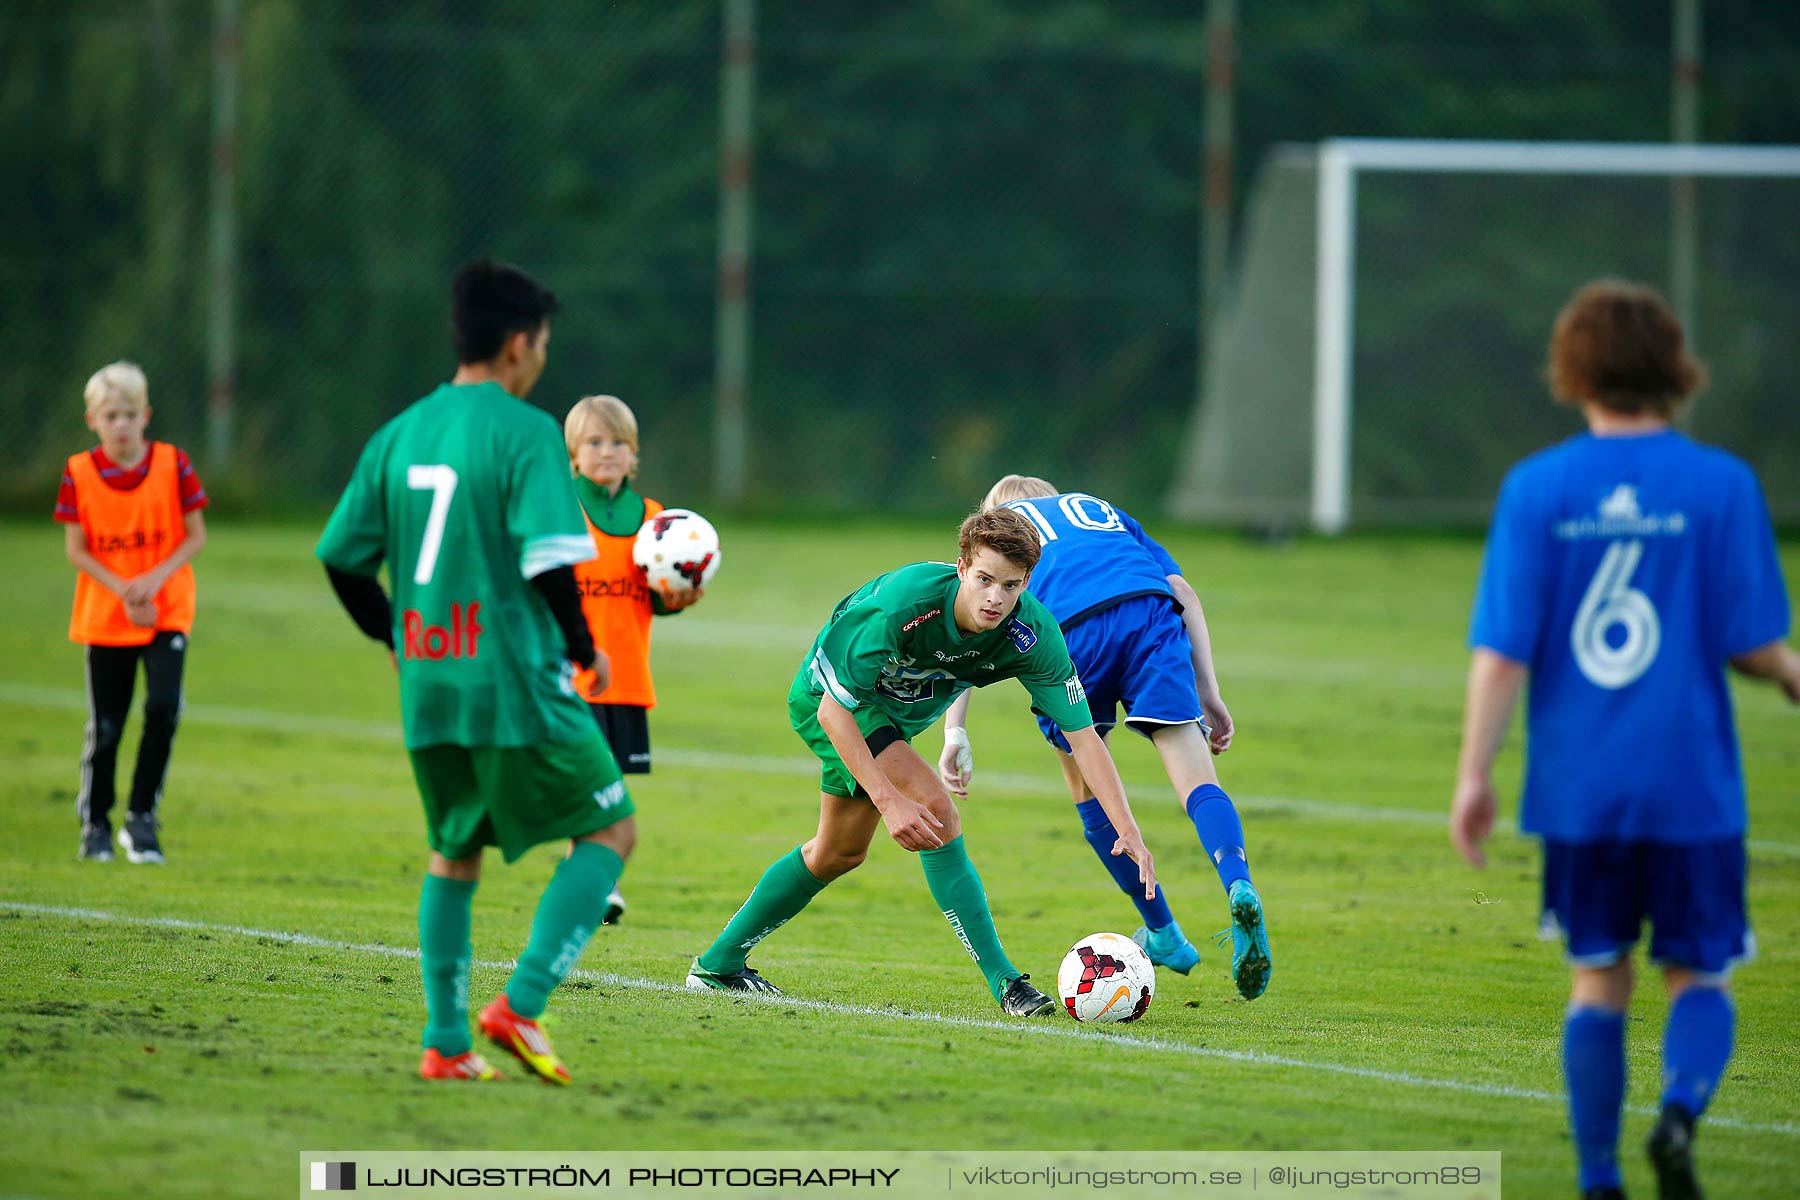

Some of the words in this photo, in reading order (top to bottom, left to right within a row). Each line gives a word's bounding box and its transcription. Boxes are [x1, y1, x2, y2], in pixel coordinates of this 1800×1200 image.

[406, 464, 458, 585] 7
[1006, 494, 1127, 548] 10
[402, 601, 482, 660] Rolf
[1569, 540, 1661, 690] 6
